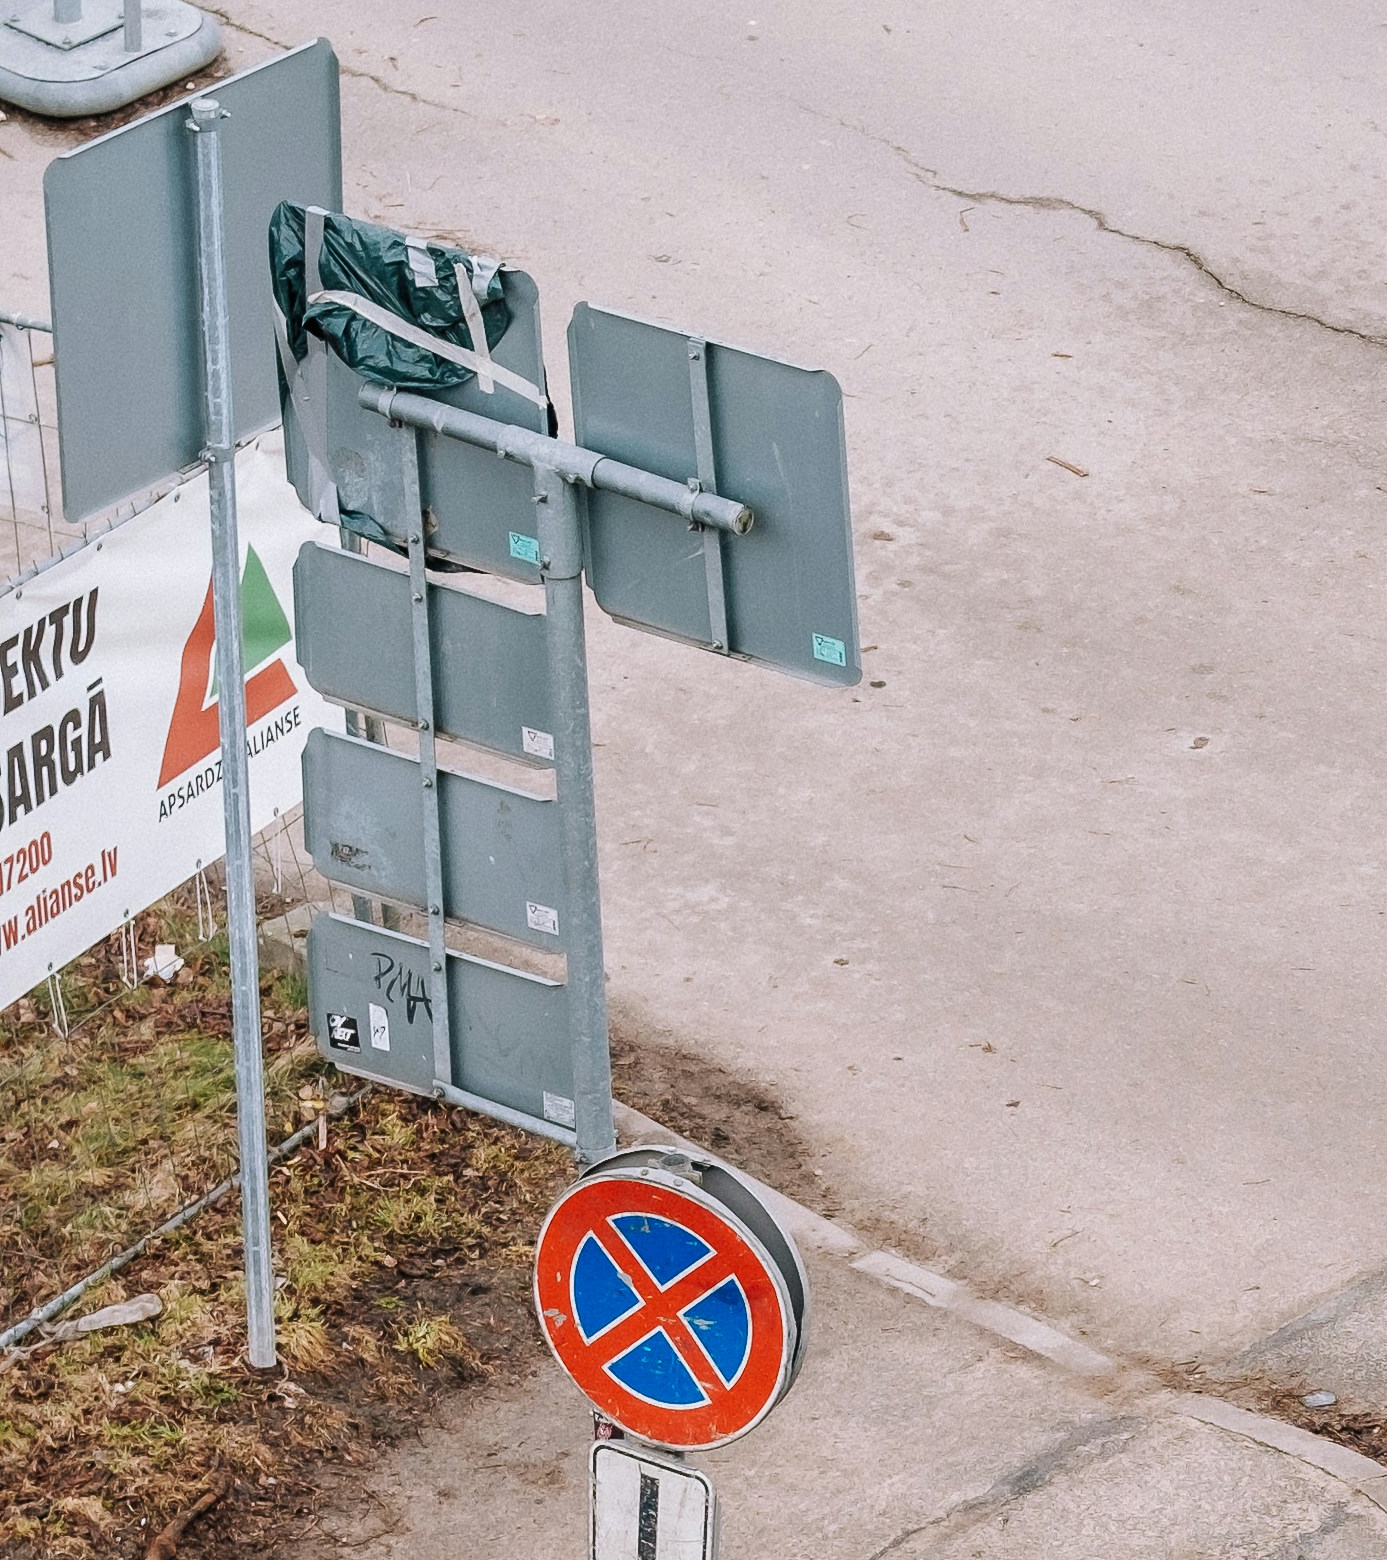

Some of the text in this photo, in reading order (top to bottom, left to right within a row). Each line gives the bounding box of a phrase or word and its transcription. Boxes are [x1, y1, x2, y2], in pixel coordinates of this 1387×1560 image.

[0, 586, 99, 717] EKTU
[159, 759, 224, 822] APSARDZ
[0, 831, 53, 897] 7200
[0, 846, 118, 956] w.alianse.lv
